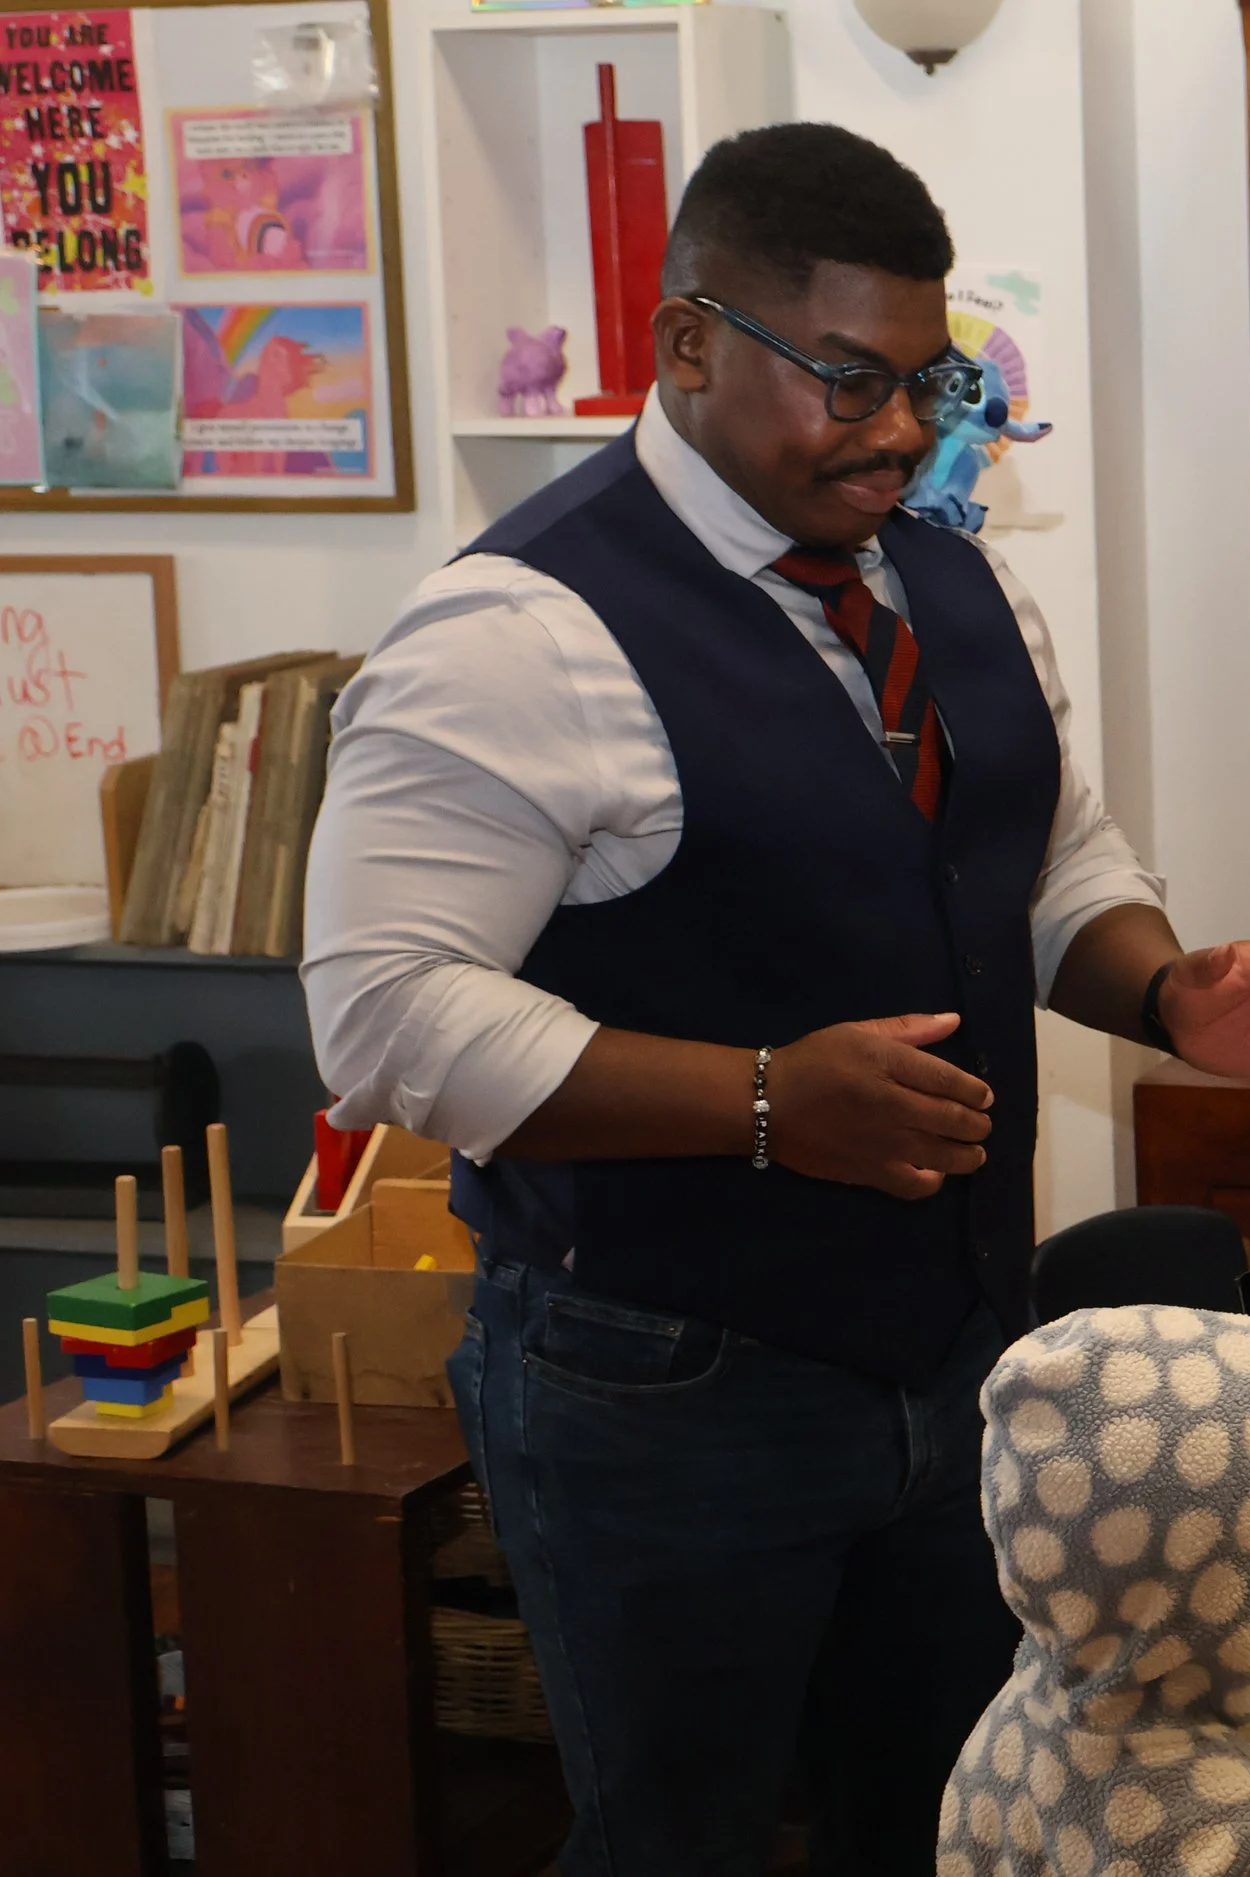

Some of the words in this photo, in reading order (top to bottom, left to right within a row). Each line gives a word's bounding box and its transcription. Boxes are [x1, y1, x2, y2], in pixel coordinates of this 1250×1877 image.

[5, 27, 50, 48] YOU
[65, 24, 109, 46] ARE
[25, 106, 104, 140] HERE
[31, 160, 113, 216] YOU
